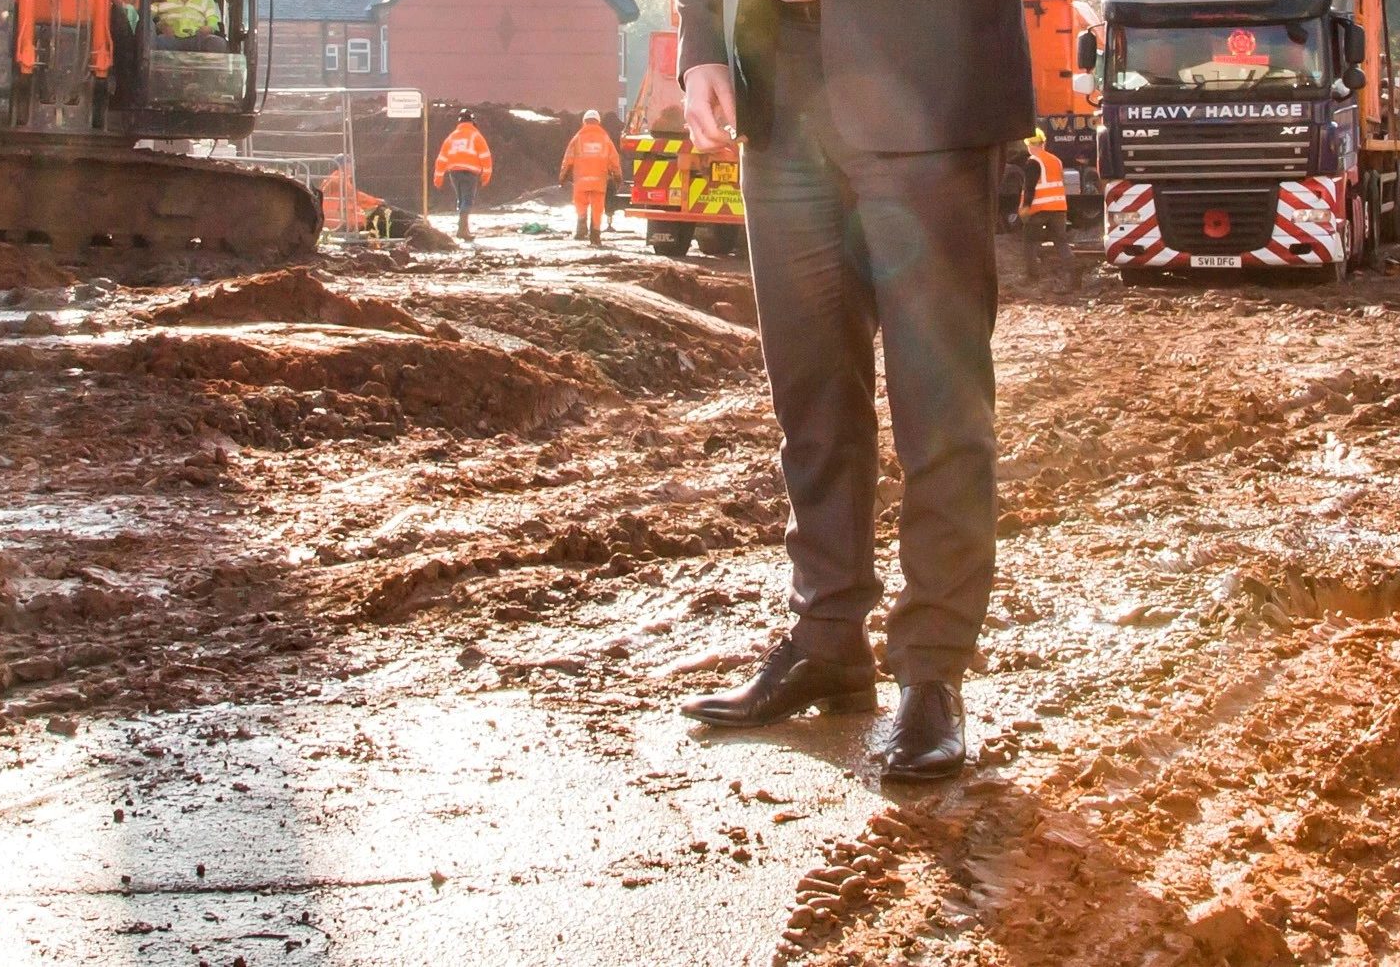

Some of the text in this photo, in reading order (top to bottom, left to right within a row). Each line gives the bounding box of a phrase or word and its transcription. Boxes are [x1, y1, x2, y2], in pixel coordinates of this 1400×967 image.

[1127, 103, 1302, 120] HEAVY HAULAGE
[1122, 129, 1159, 138] DAF
[1280, 126, 1309, 135] XF
[1217, 257, 1235, 266] DFG
